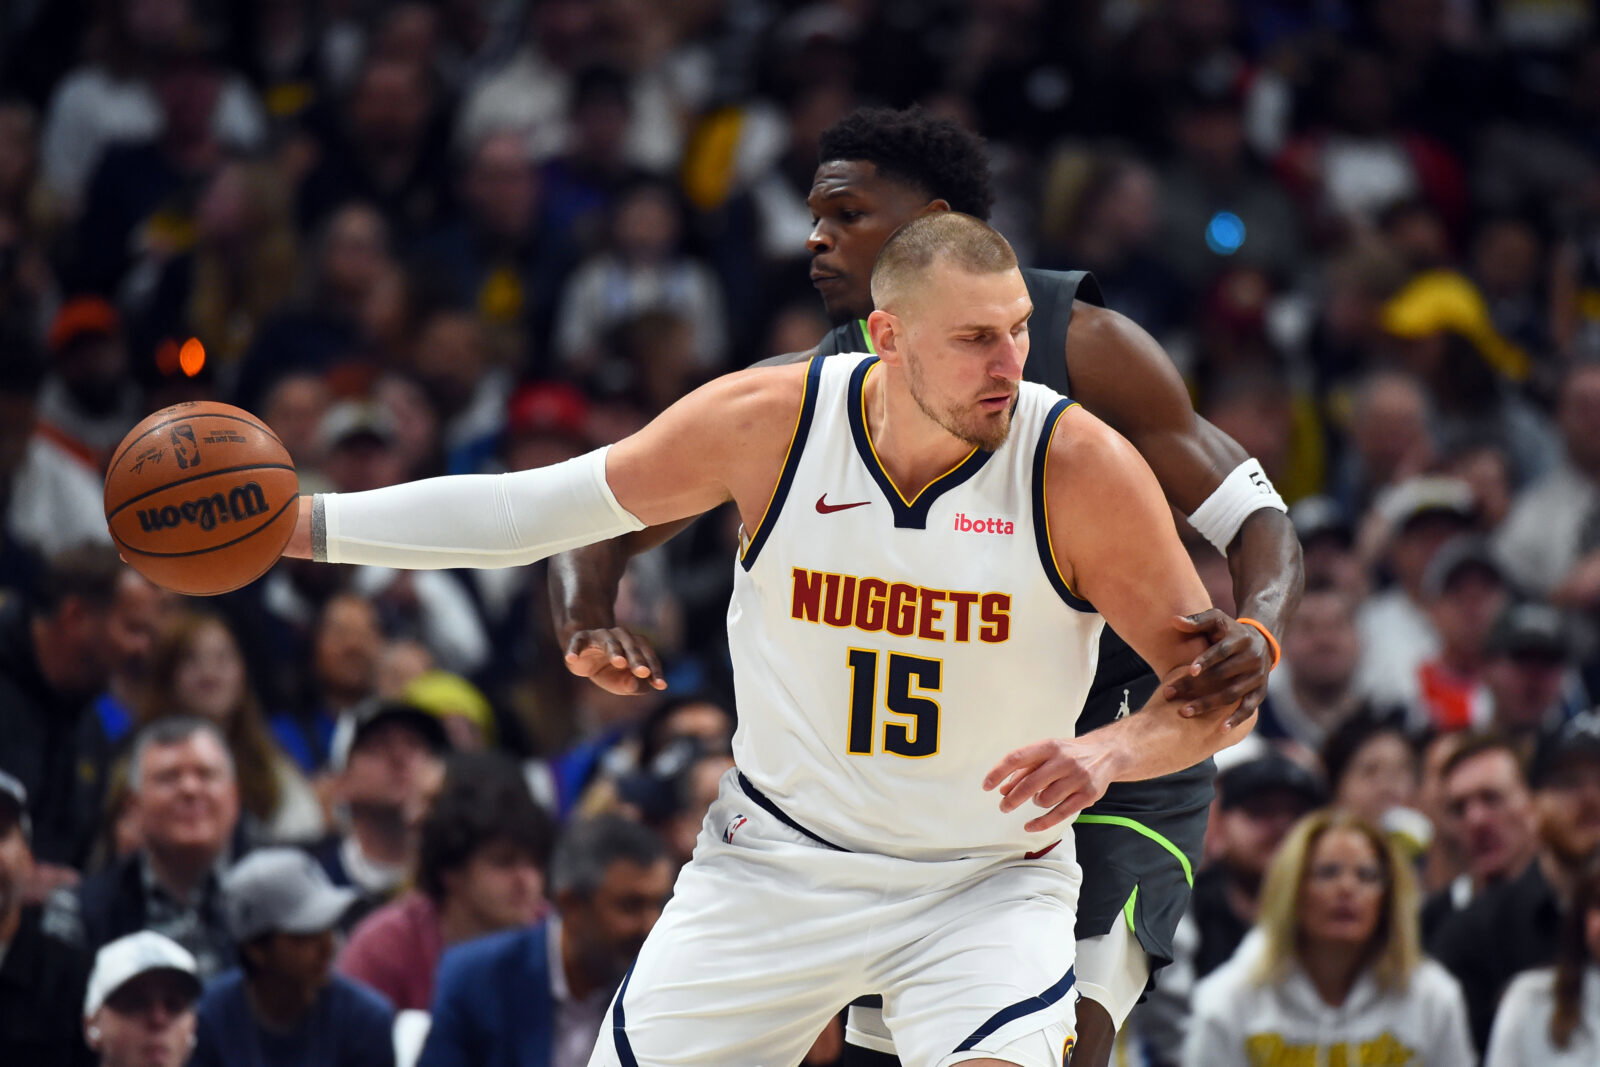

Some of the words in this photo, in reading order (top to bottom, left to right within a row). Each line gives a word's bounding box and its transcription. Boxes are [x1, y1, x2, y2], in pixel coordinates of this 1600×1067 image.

[136, 481, 269, 532] Wilson
[954, 513, 1014, 535] ibotta
[791, 566, 1012, 643] NUGGETS
[846, 646, 943, 759] 15
